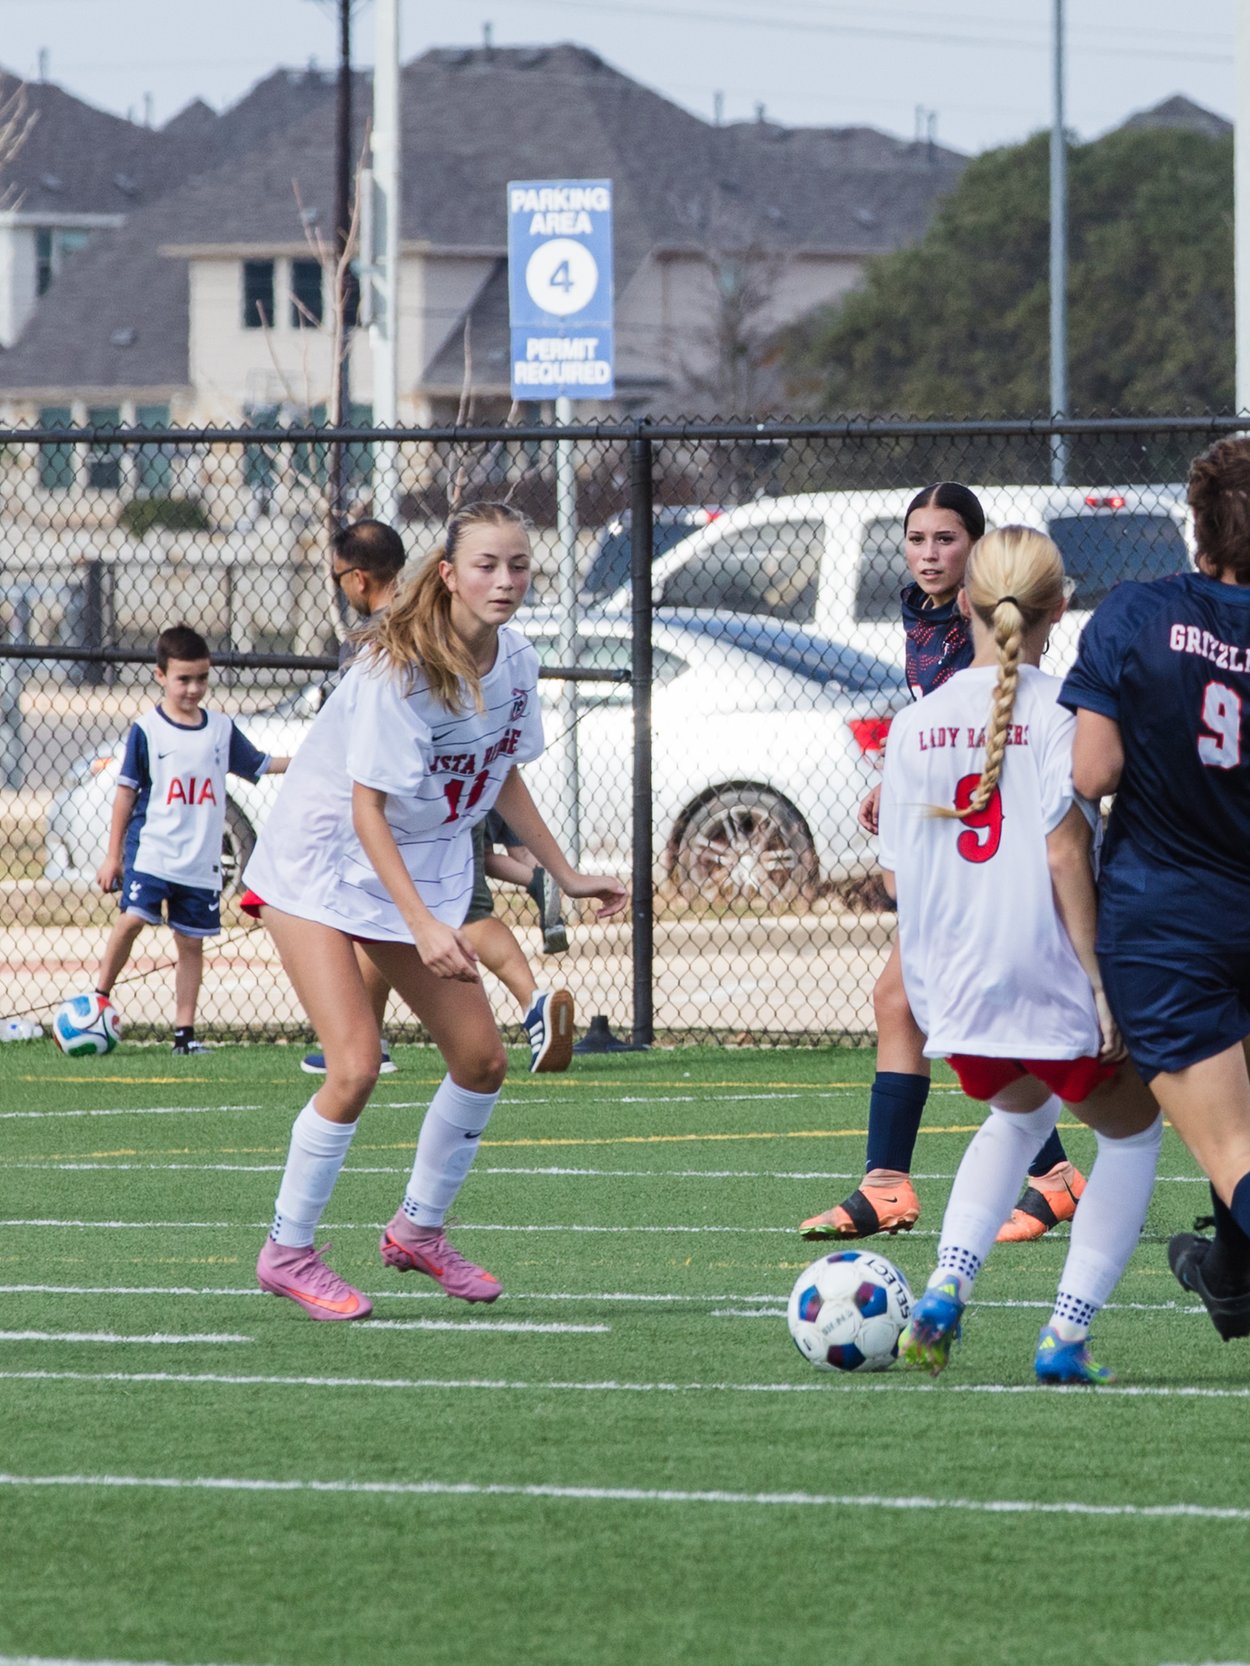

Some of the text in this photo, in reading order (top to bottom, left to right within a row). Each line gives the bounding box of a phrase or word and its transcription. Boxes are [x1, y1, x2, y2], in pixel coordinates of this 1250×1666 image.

[511, 188, 609, 212] PARKING
[529, 211, 593, 235] AREA
[549, 259, 574, 293] 4
[526, 337, 599, 360] PERMIT
[514, 361, 611, 385] REQUIRED
[918, 724, 1029, 751] LADY RAERS
[1197, 680, 1242, 770] 9
[430, 753, 476, 775] ISTA
[166, 776, 217, 807] AIA
[953, 772, 1005, 864] 9
[863, 1258, 912, 1320] SELECT
